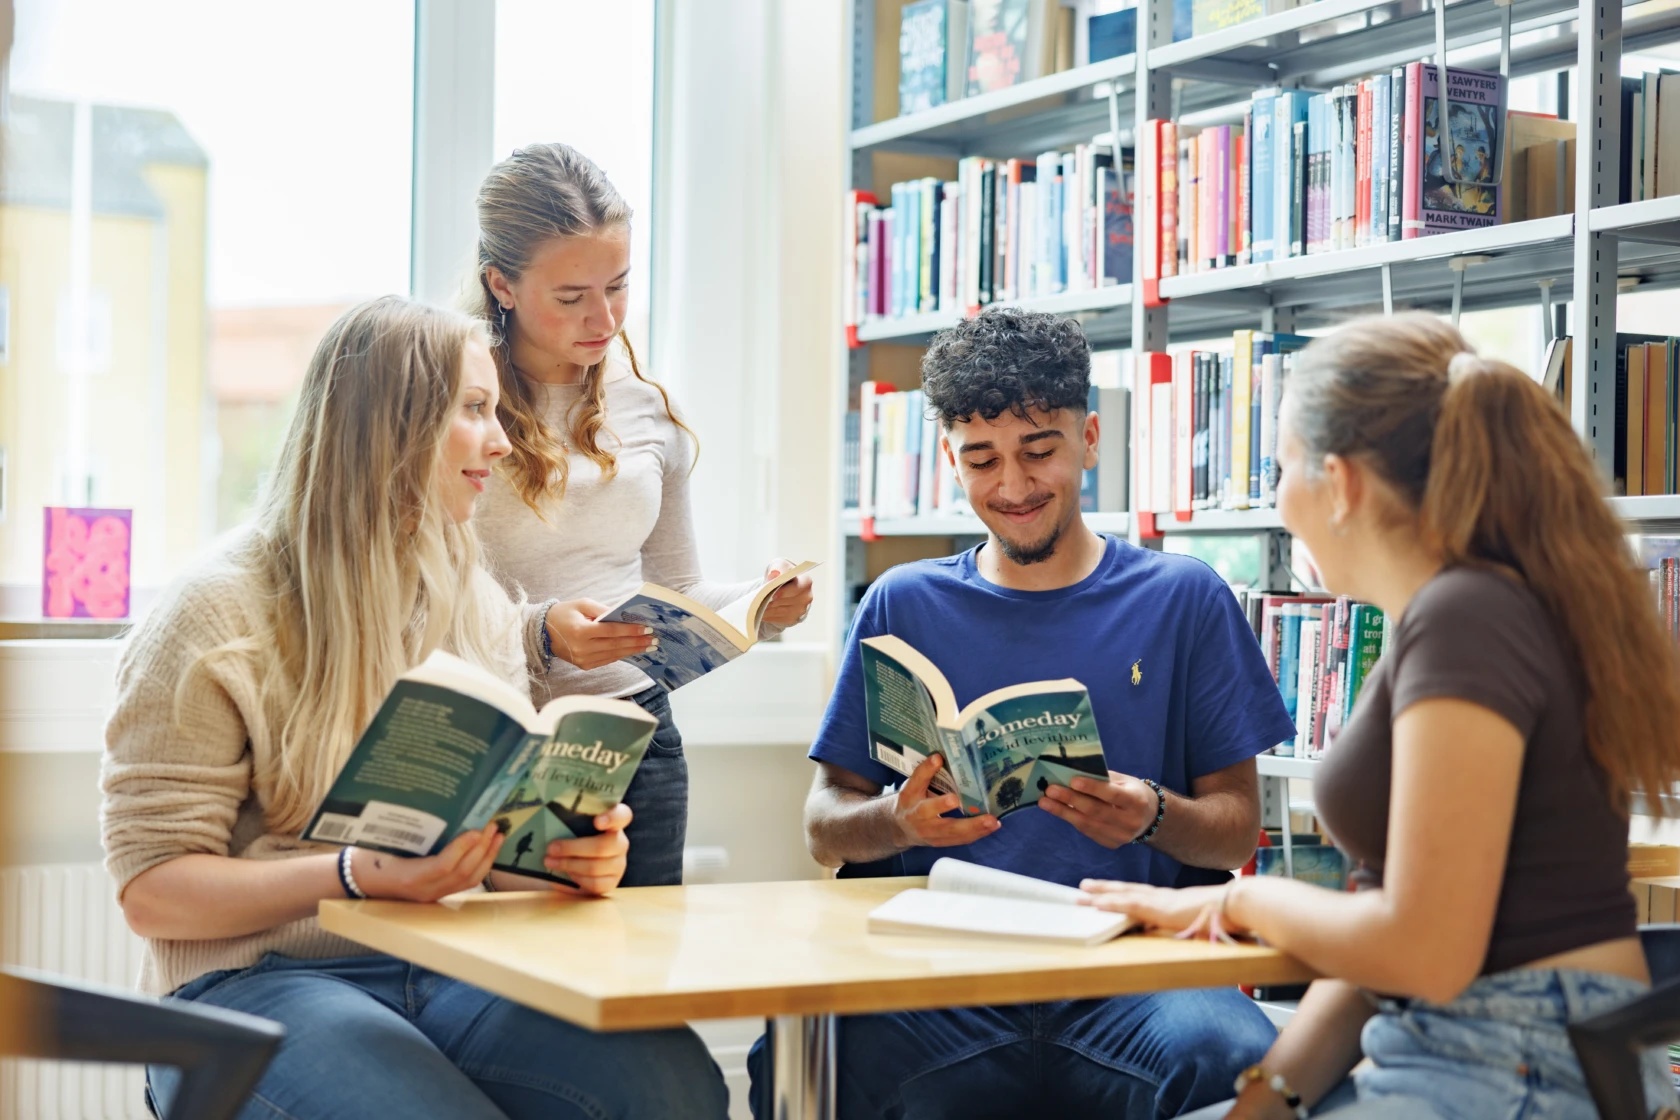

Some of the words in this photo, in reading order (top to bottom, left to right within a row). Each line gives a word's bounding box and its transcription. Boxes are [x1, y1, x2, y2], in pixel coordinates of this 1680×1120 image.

[1452, 76, 1496, 90] SAWYERS
[1446, 87, 1486, 101] VENTYR
[1391, 113, 1399, 176] NAONDEL
[1426, 213, 1457, 225] MARK
[1460, 216, 1494, 228] TWAIN
[1365, 612, 1370, 624] I
[976, 711, 1082, 748] someday
[1023, 731, 1088, 746] levithan
[550, 767, 615, 795] levithan
